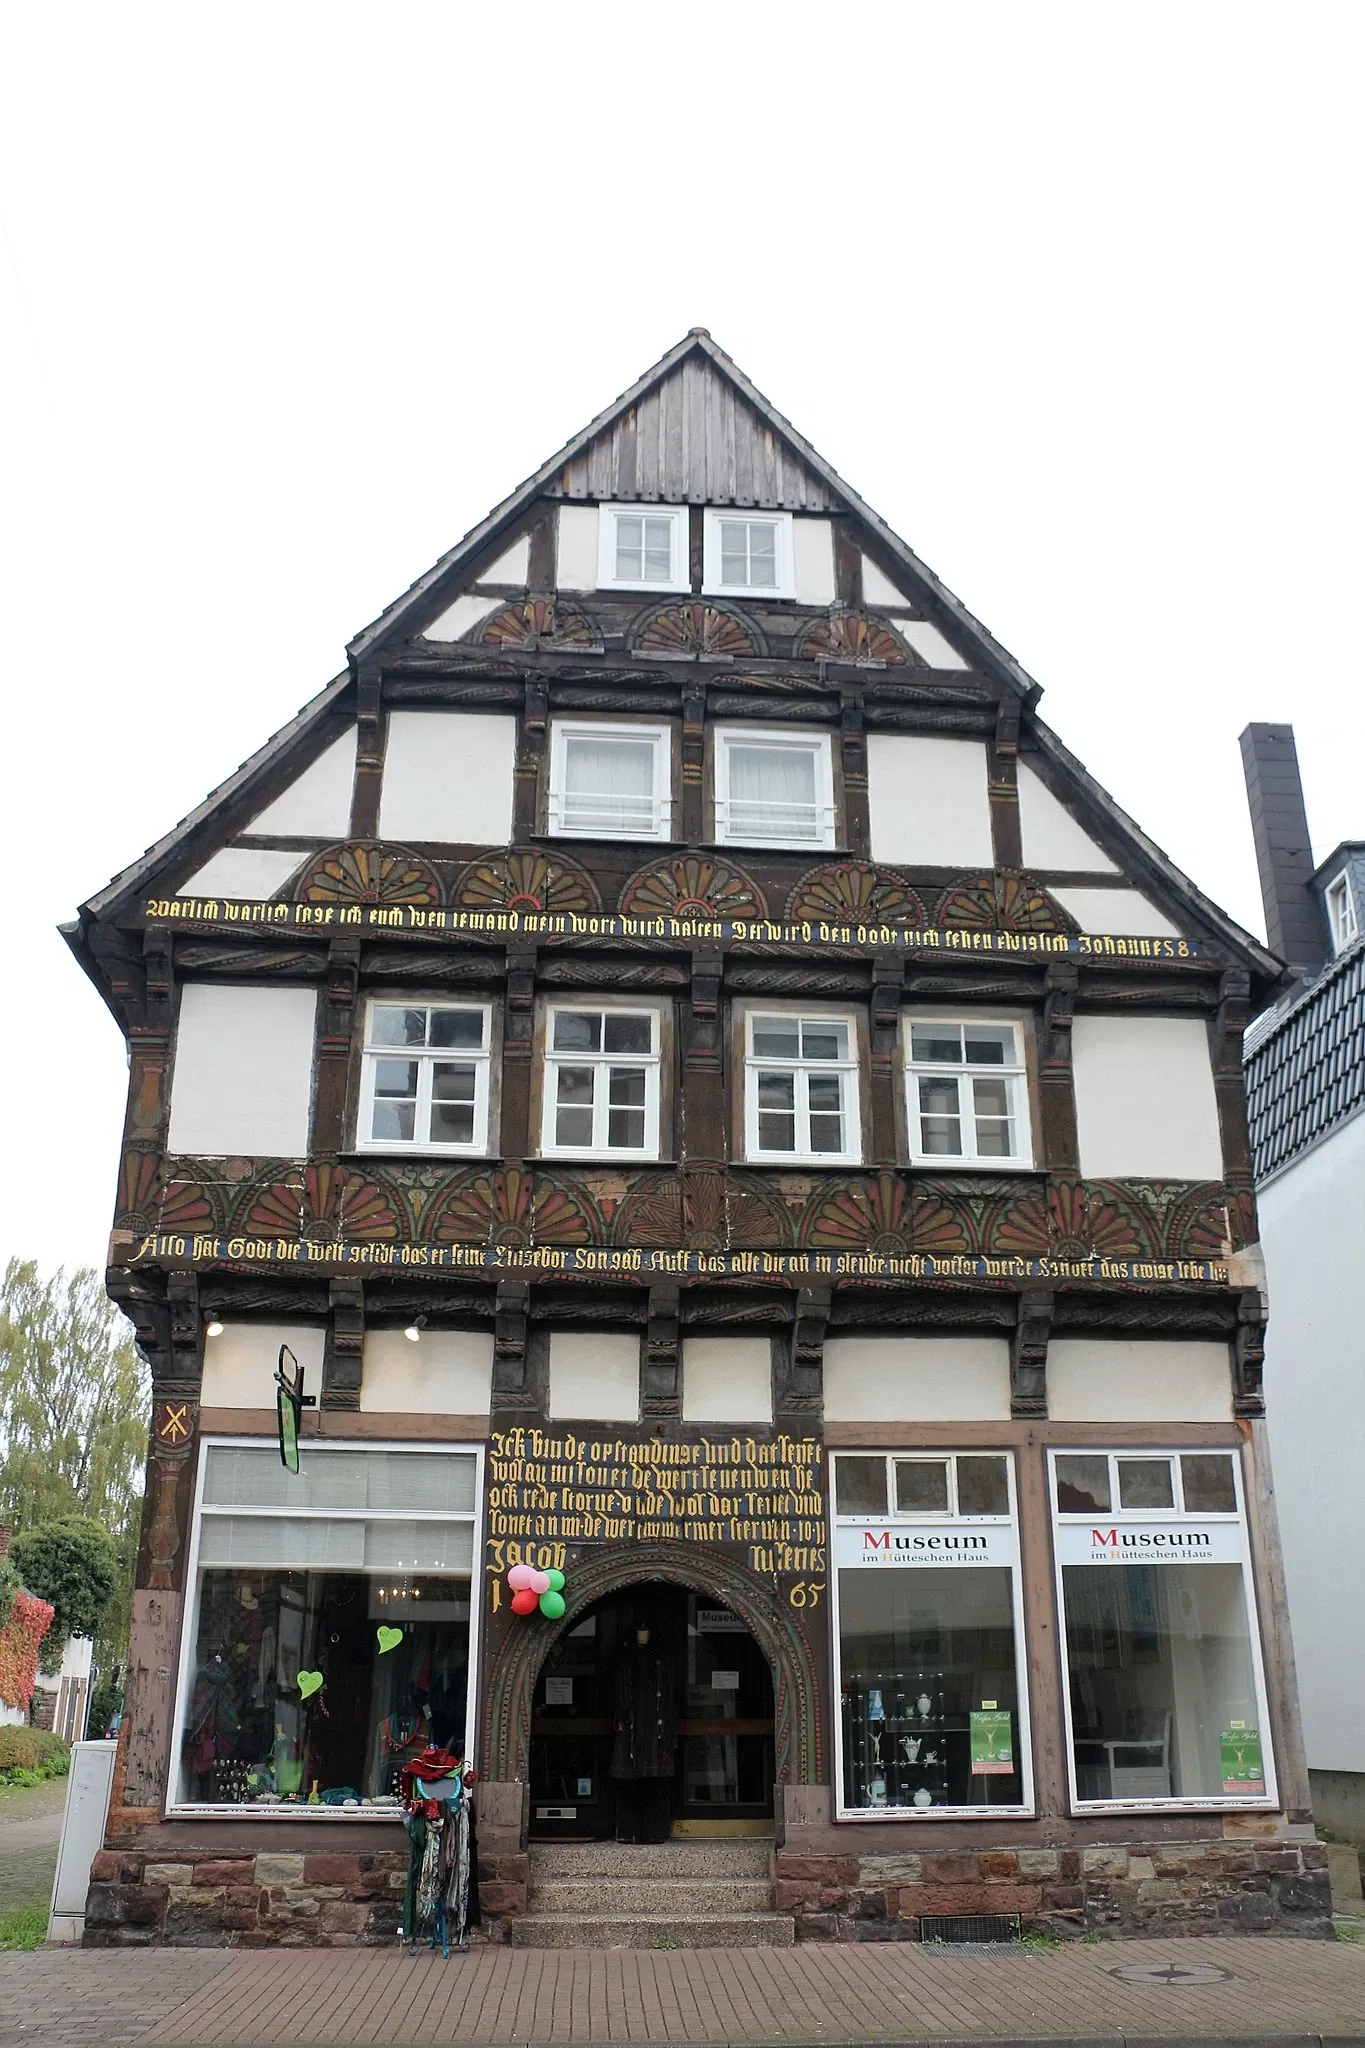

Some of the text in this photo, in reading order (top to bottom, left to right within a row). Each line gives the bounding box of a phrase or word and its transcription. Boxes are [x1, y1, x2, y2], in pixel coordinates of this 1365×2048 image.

[862, 1531, 988, 1549] Museum
[1090, 1529, 1212, 1546] Museum
[862, 1552, 989, 1562] im Hütteschen Haus
[1091, 1549, 1213, 1560] im Hütteschen Haus
[790, 1581, 826, 1608] 65
